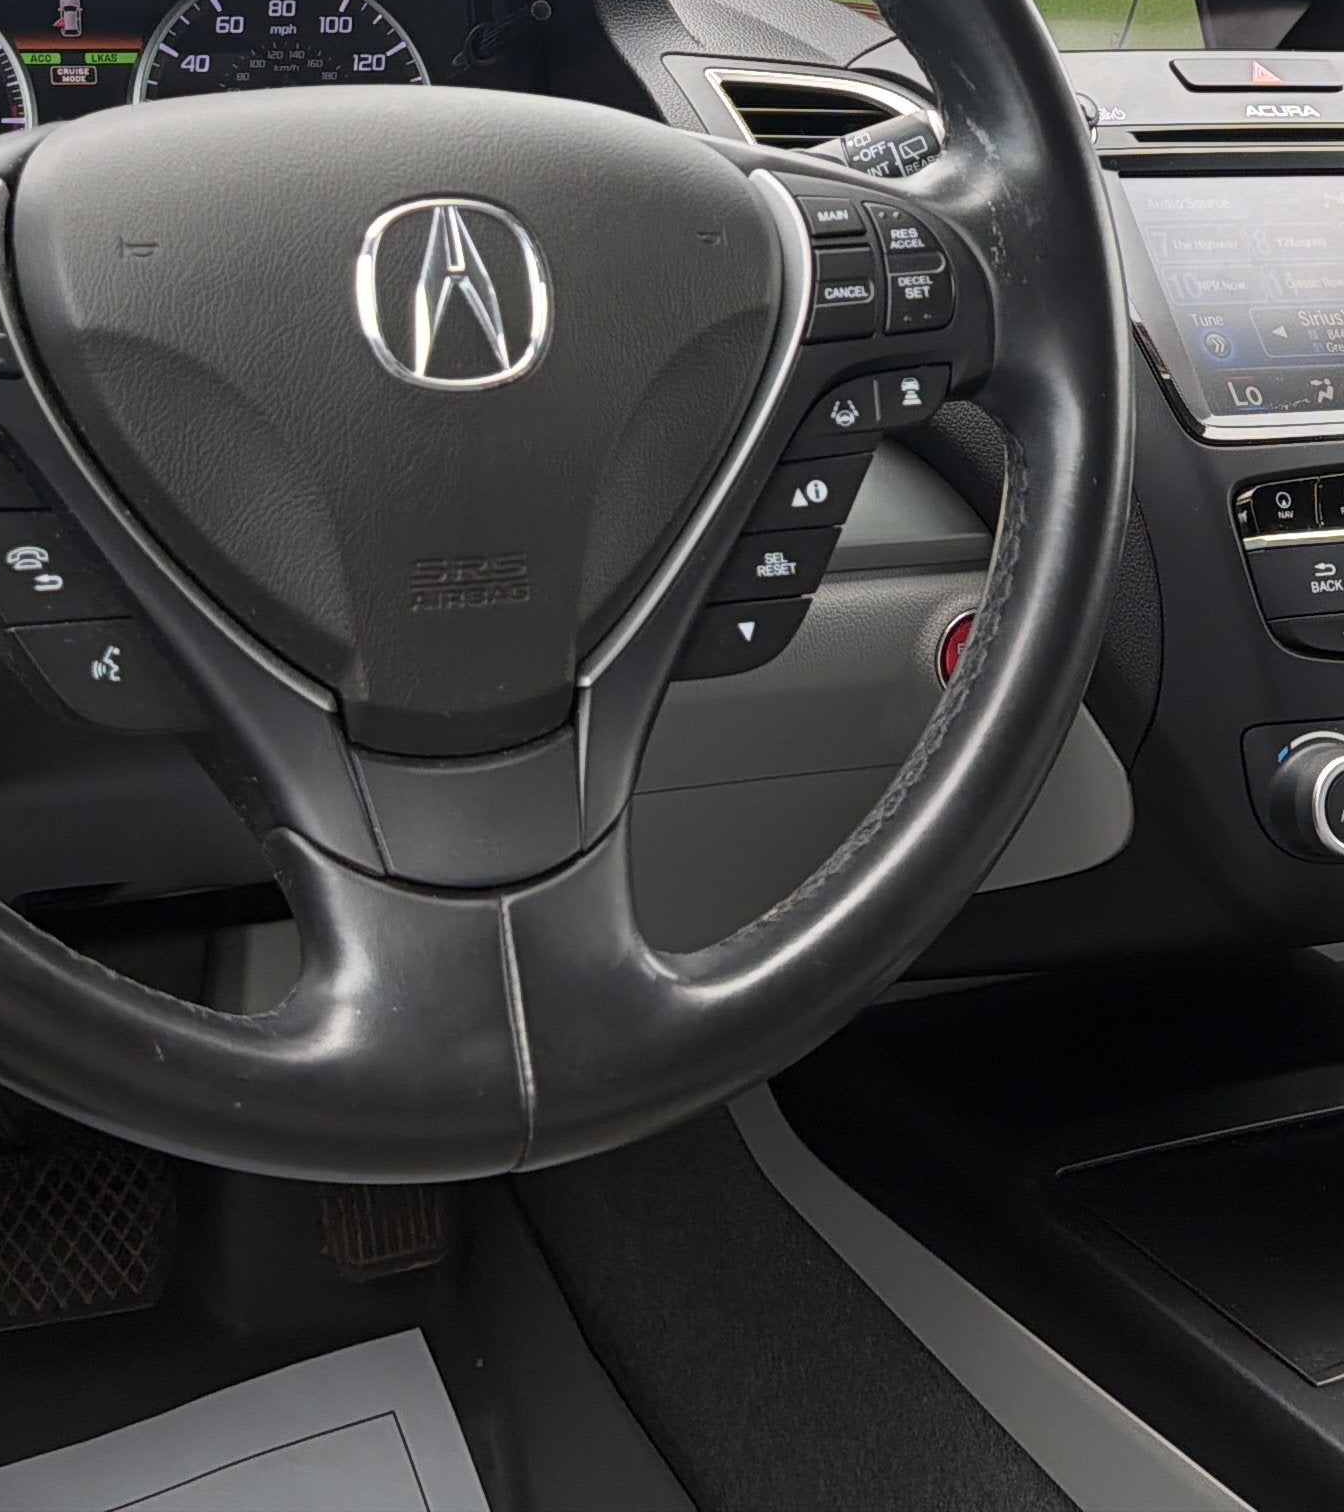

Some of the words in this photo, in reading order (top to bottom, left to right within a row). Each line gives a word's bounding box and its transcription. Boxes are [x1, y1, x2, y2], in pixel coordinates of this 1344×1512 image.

[268, 0, 296, 17] 80
[215, 16, 244, 34] 60
[269, 24, 297, 37] mph
[319, 16, 353, 34] 100
[30, 54, 52, 63] ACC
[91, 54, 118, 63] LKAS
[267, 50, 284, 60] 120
[288, 50, 305, 60] 140
[180, 54, 210, 73] 40
[249, 59, 266, 69] 100
[273, 63, 300, 73] km/h
[306, 59, 323, 69] 160
[353, 54, 386, 72] 120
[56, 68, 90, 76] CRUISE
[236, 71, 250, 81] 80
[321, 71, 338, 80] 180
[62, 75, 87, 83] MODE
[1245, 104, 1321, 118] ACURA
[817, 209, 848, 222] MAIN
[890, 228, 918, 239] RES
[890, 239, 926, 249] ACCEL
[898, 275, 933, 286] DECEL
[824, 286, 868, 300] CANCEL
[905, 286, 931, 299] SET
[1190, 313, 1225, 327] Tune
[1227, 381, 1263, 406] Lo
[1277, 509, 1295, 520] NAV
[764, 552, 788, 563] SEL
[411, 552, 528, 583] SRS
[756, 562, 797, 577] RESET
[1310, 578, 1344, 593] BACK
